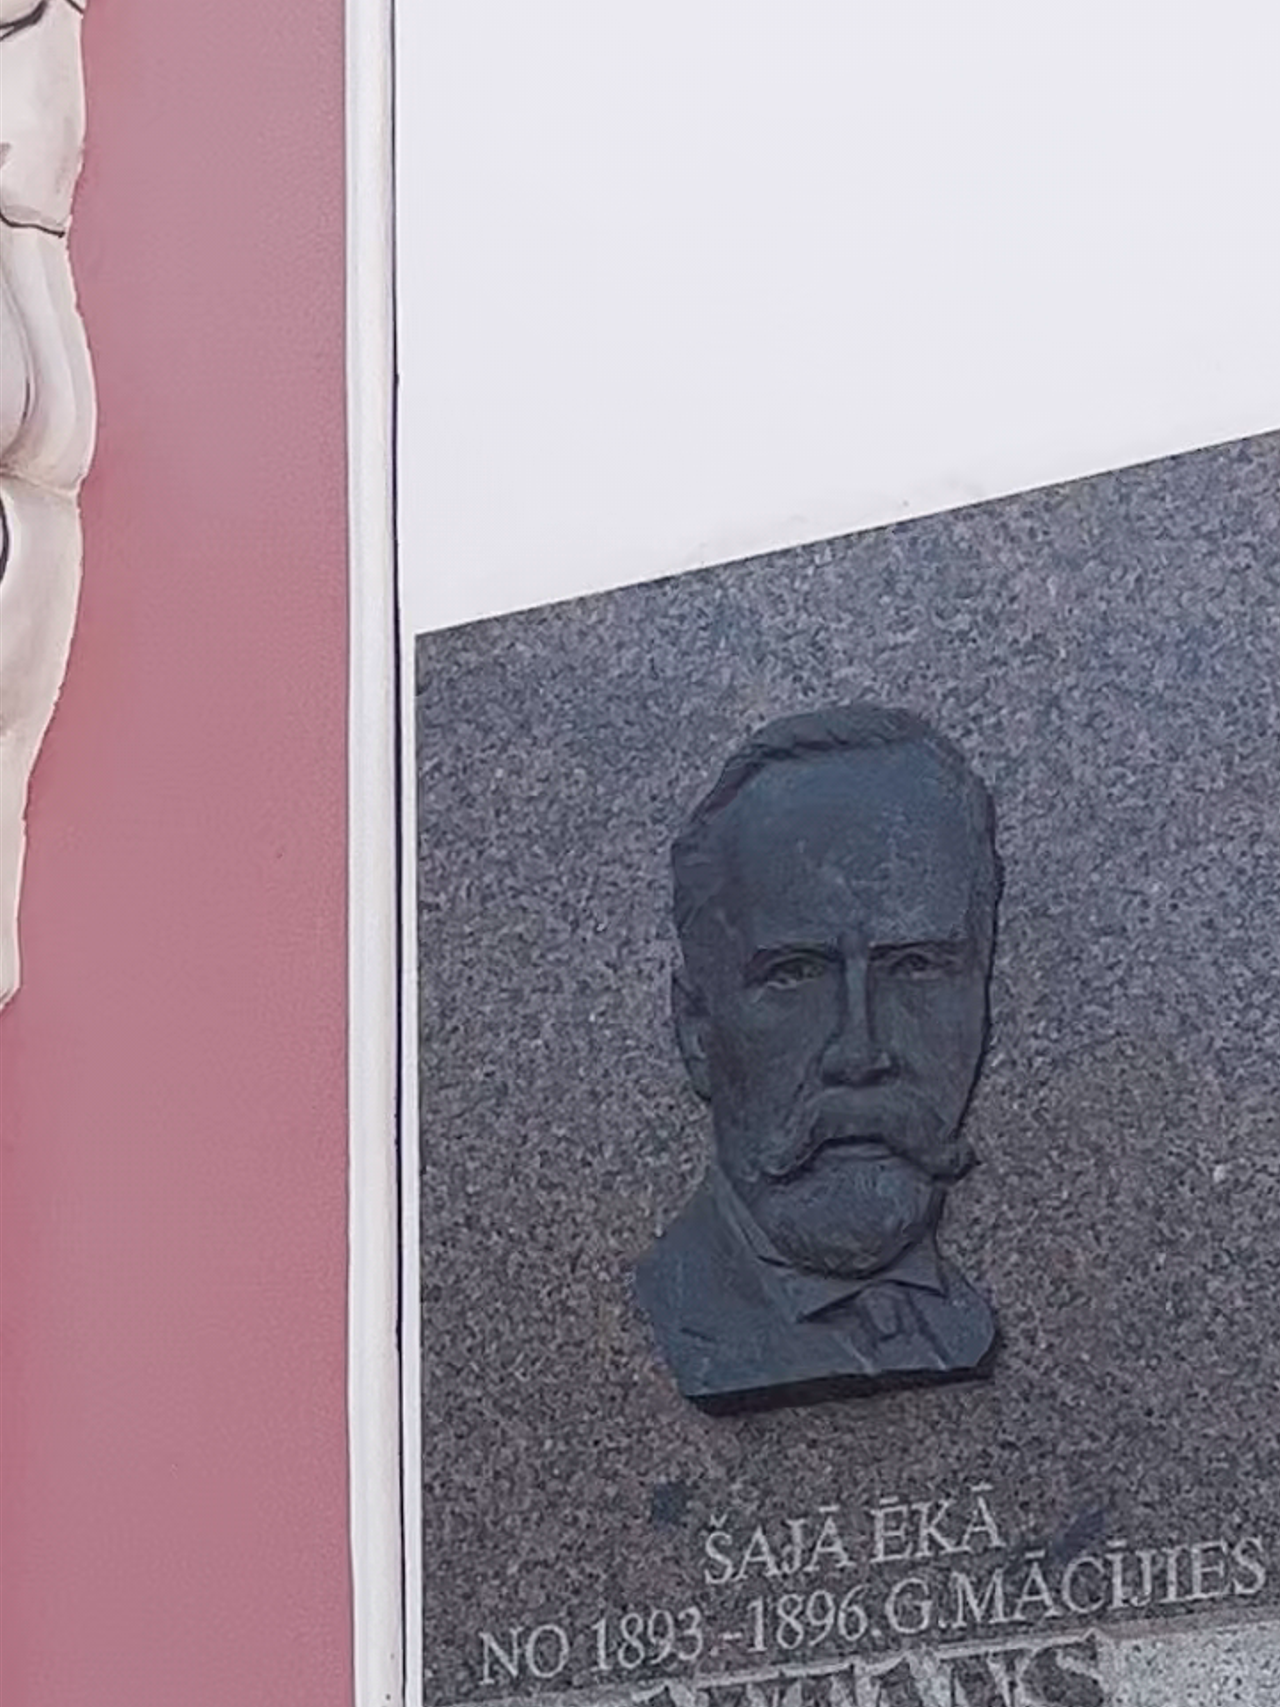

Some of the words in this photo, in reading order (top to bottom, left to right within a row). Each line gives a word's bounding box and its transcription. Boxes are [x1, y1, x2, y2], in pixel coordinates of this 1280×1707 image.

[705, 1508, 854, 1586] ŠAJĀ
[868, 1486, 1006, 1563] ĒKĀ
[480, 1623, 570, 1685] NO
